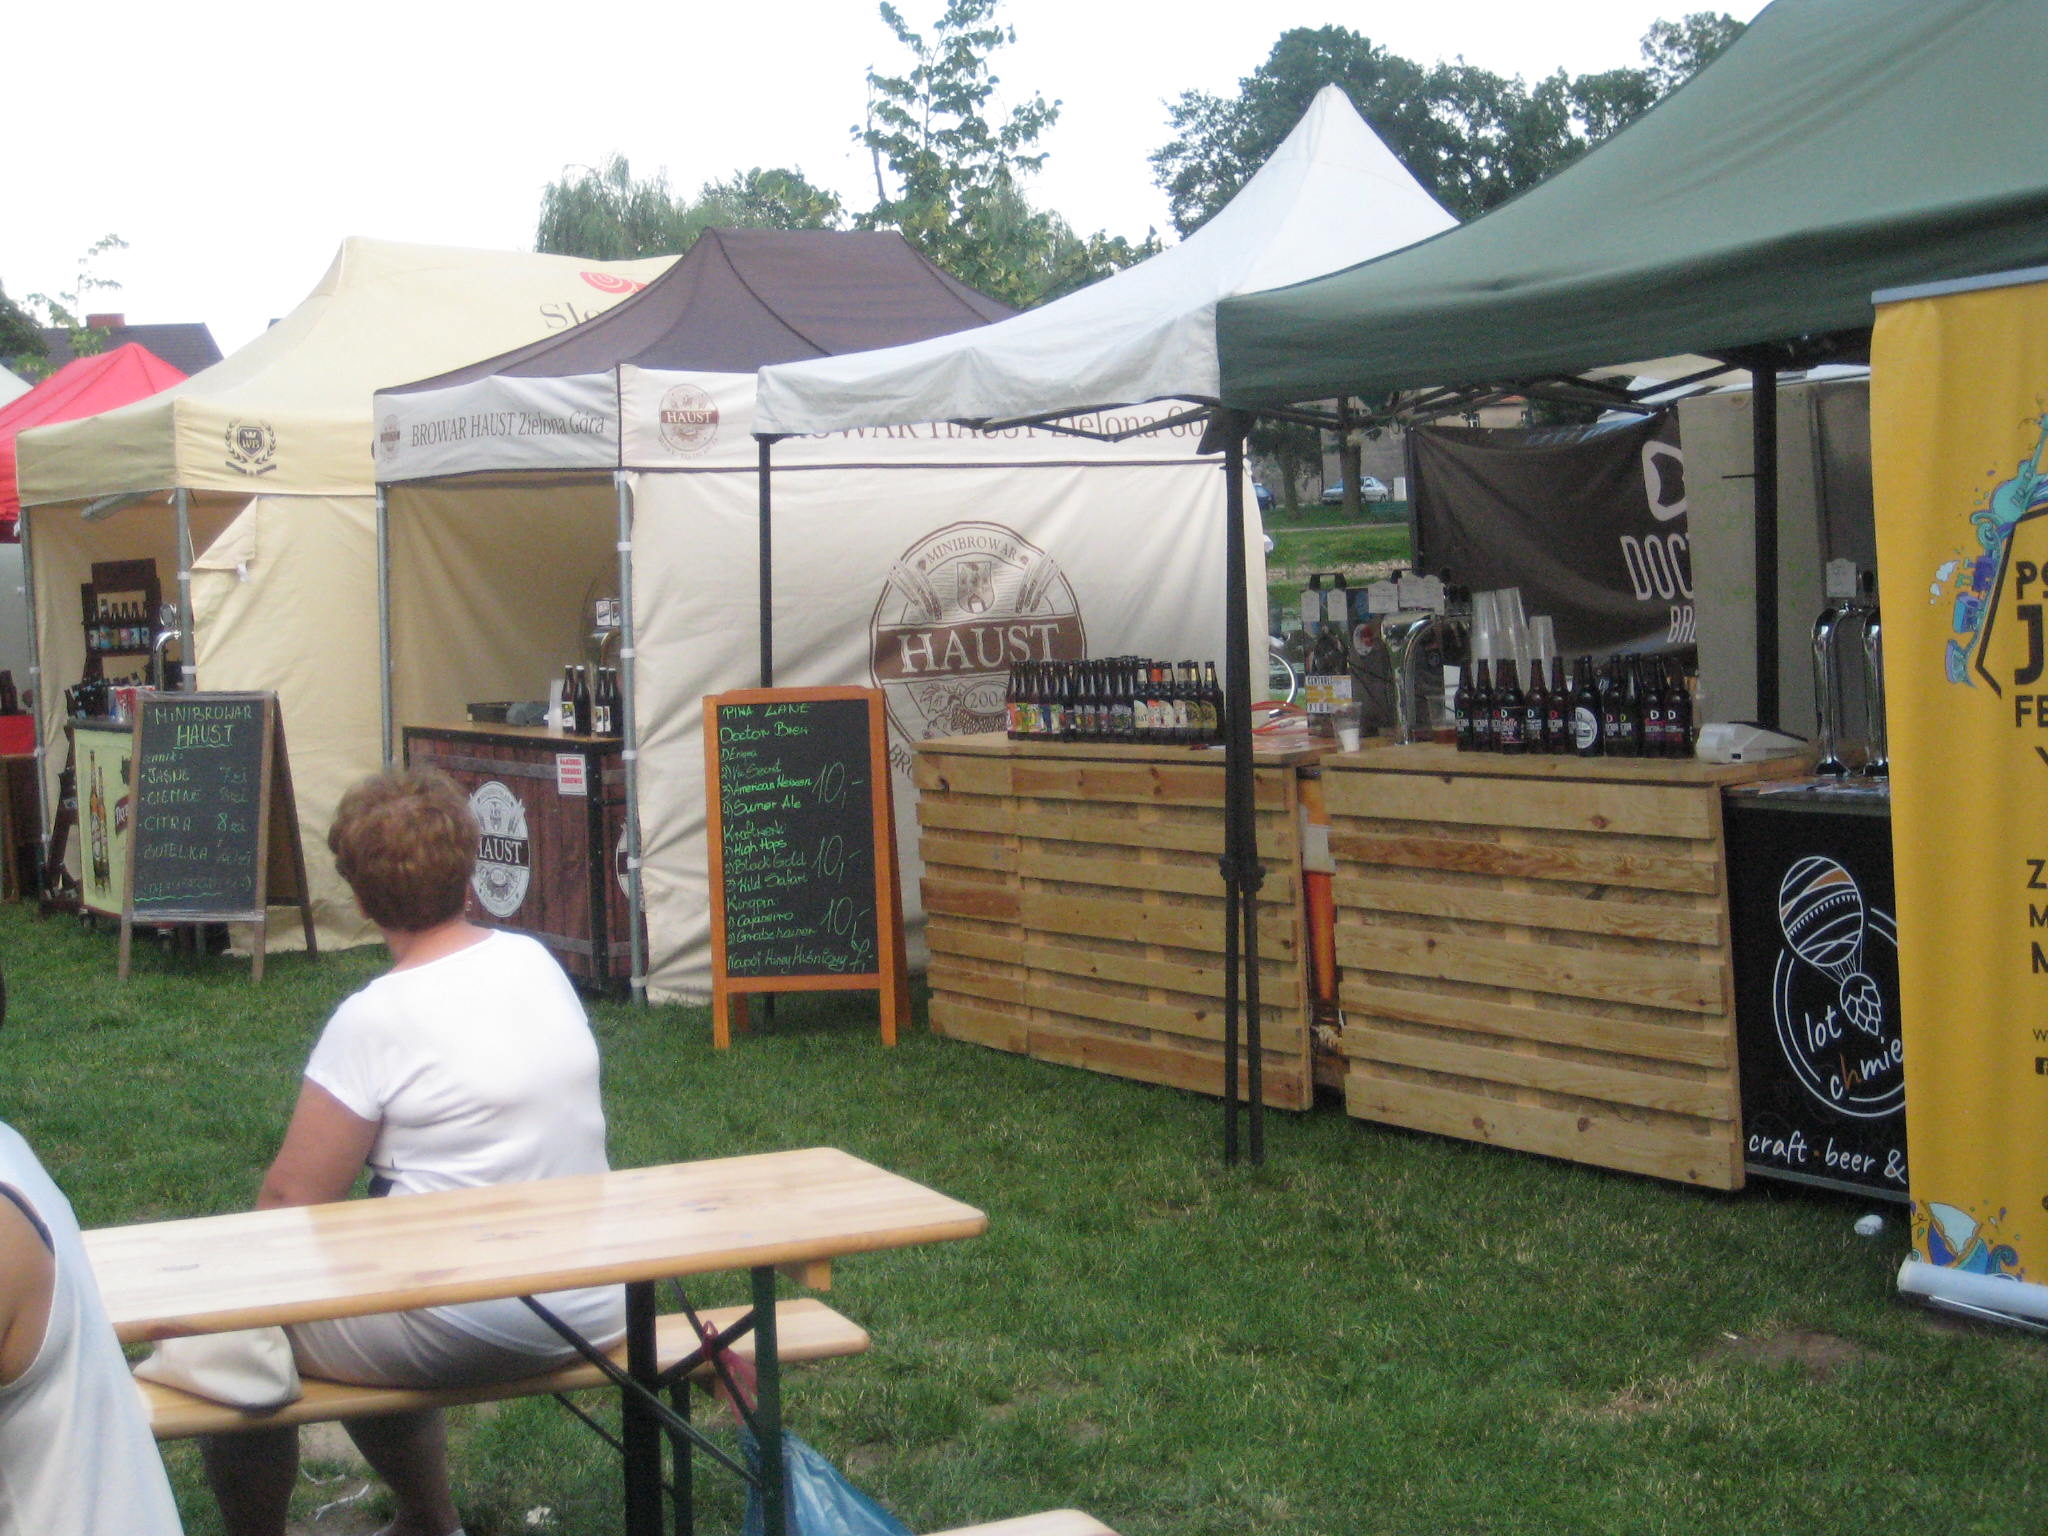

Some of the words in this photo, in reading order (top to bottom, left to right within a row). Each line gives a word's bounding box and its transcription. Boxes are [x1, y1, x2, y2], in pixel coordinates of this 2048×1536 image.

[411, 416, 467, 447] BROWAR
[471, 412, 516, 438] HAUST
[518, 411, 567, 435] Zielona
[569, 411, 605, 434] Góra
[666, 411, 712, 423] HAUST
[926, 536, 1018, 564] MINIBROWAR
[1620, 532, 1694, 600] DOC
[898, 623, 1060, 673] HAUST
[2015, 695, 2048, 728] FE
[176, 723, 234, 748] HAUST
[720, 725, 770, 744] Doctor
[782, 794, 801, 810] Ale
[144, 814, 191, 832] CITRA
[735, 841, 758, 857] High
[760, 838, 787, 854] Hops
[773, 851, 807, 868] Gold
[1805, 1005, 1842, 1053] lot
[1749, 1131, 1808, 1164] craft
[1825, 1137, 1876, 1173] beer
[1884, 1149, 1907, 1184] &
